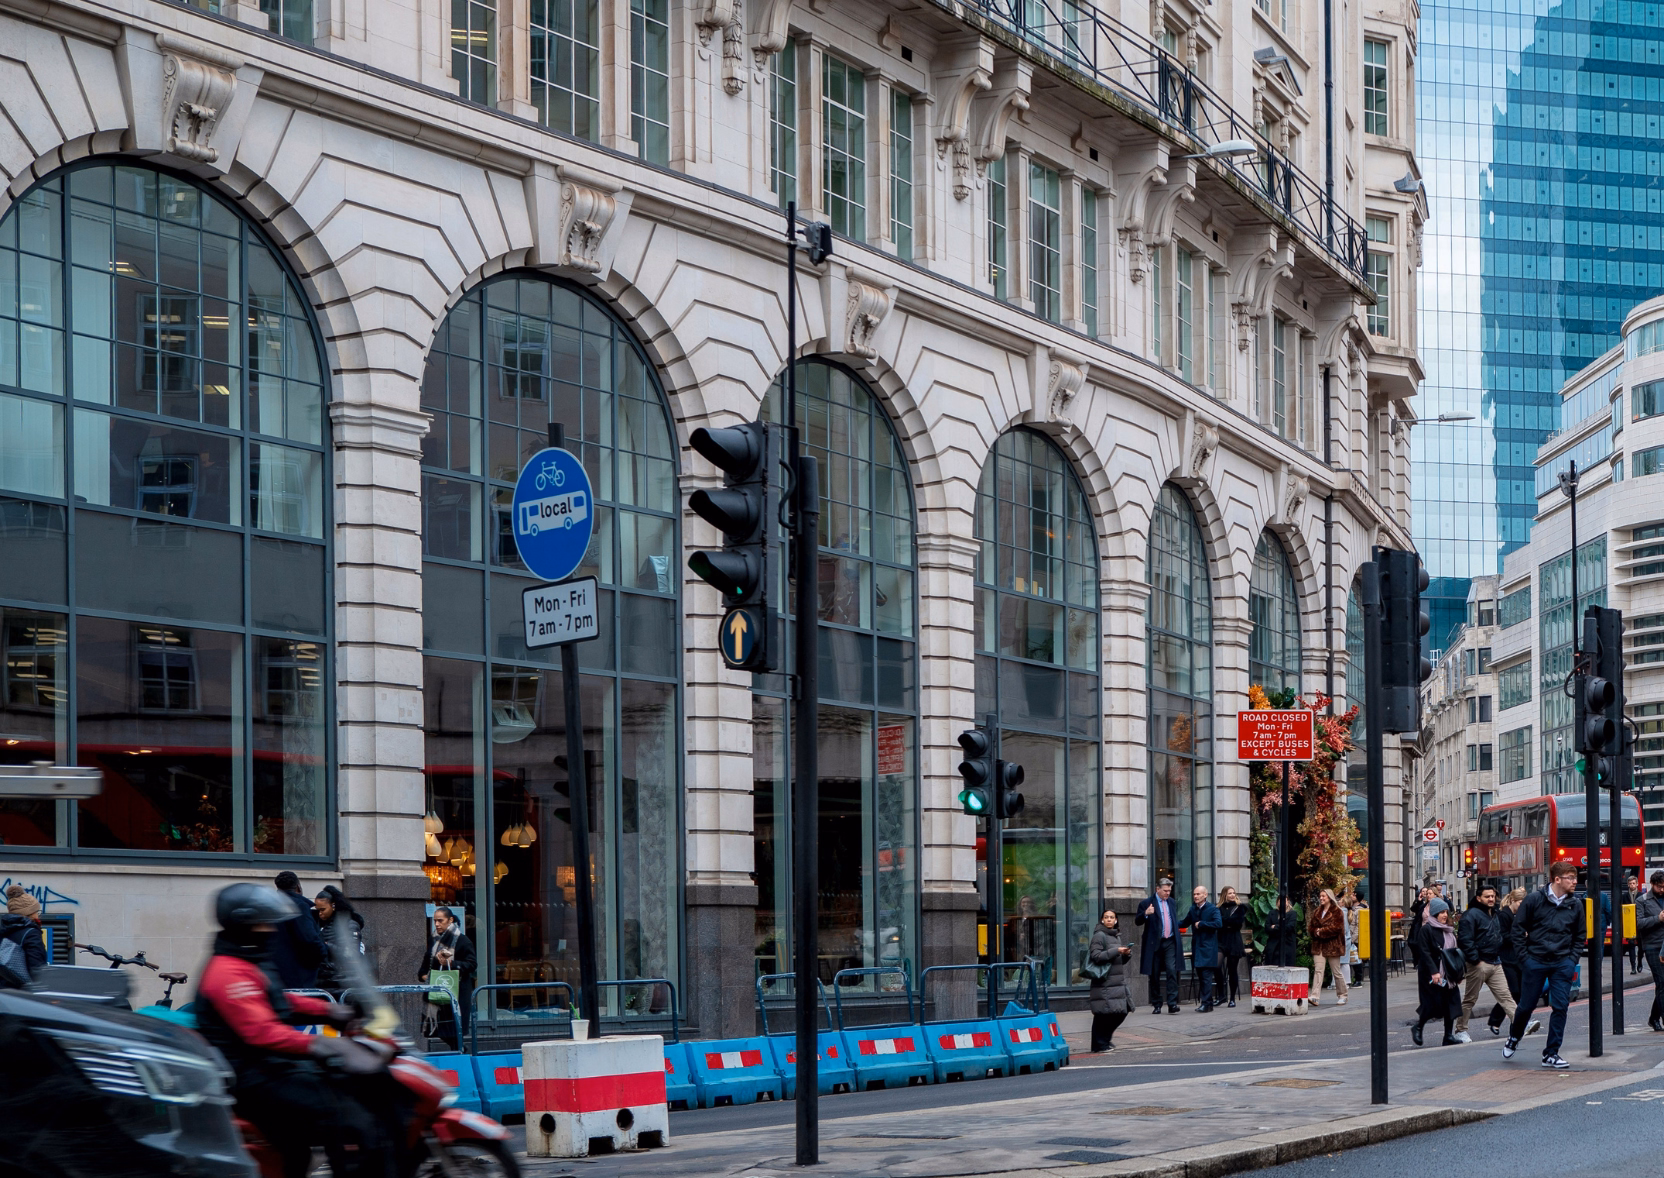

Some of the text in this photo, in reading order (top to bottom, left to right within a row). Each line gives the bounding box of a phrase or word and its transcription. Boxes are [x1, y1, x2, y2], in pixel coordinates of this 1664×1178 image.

[540, 497, 572, 519] local
[534, 596, 560, 614] Mon
[570, 589, 586, 608] Fri
[1242, 714, 1308, 722] ROAD CLOSED
[1257, 722, 1276, 731] Mon
[1281, 722, 1293, 731] Fri
[1241, 740, 1309, 748] EXCEPT BUSES
[1253, 748, 1297, 757] & CYCLES
